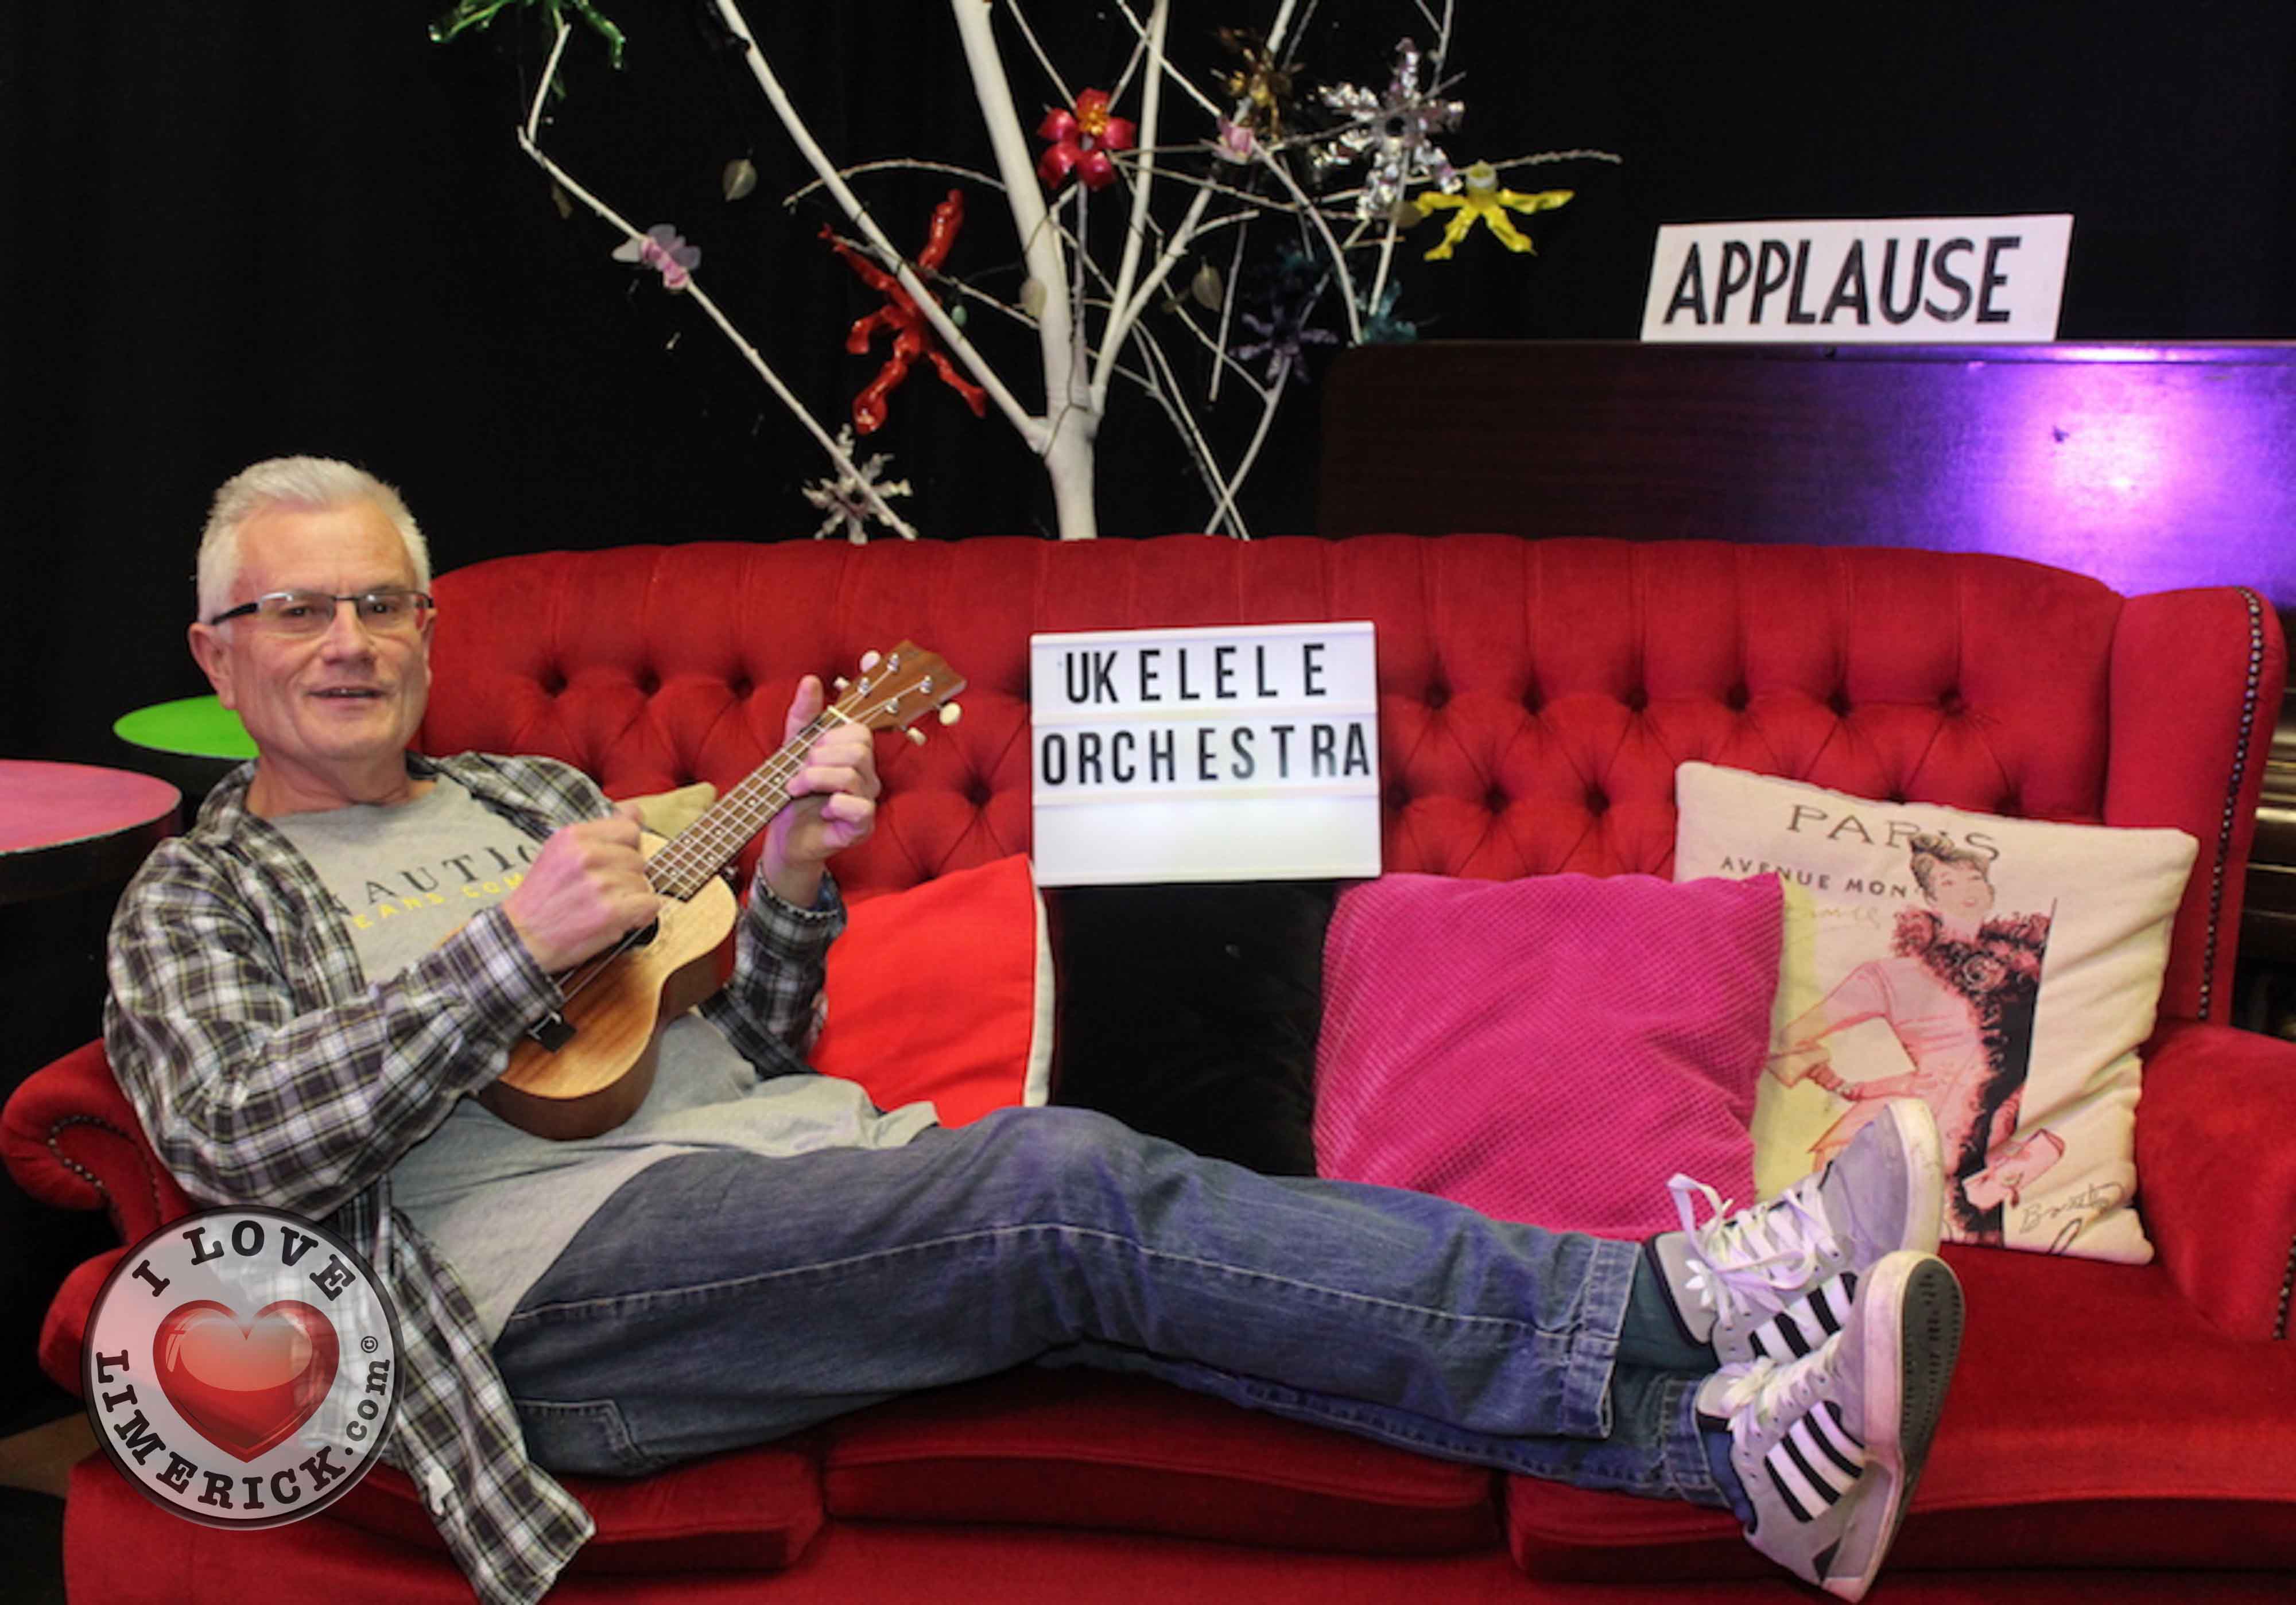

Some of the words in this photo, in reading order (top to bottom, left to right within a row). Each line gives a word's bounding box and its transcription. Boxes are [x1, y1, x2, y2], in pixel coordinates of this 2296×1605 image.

[1662, 236, 2021, 325] APPLAUSE
[1066, 643, 1326, 704] UKELELE
[1042, 722, 1370, 785] ORCHESTRA
[1786, 805, 1999, 861] PARS
[1720, 856, 1830, 889] AVENUE
[1845, 879, 1919, 897] MON
